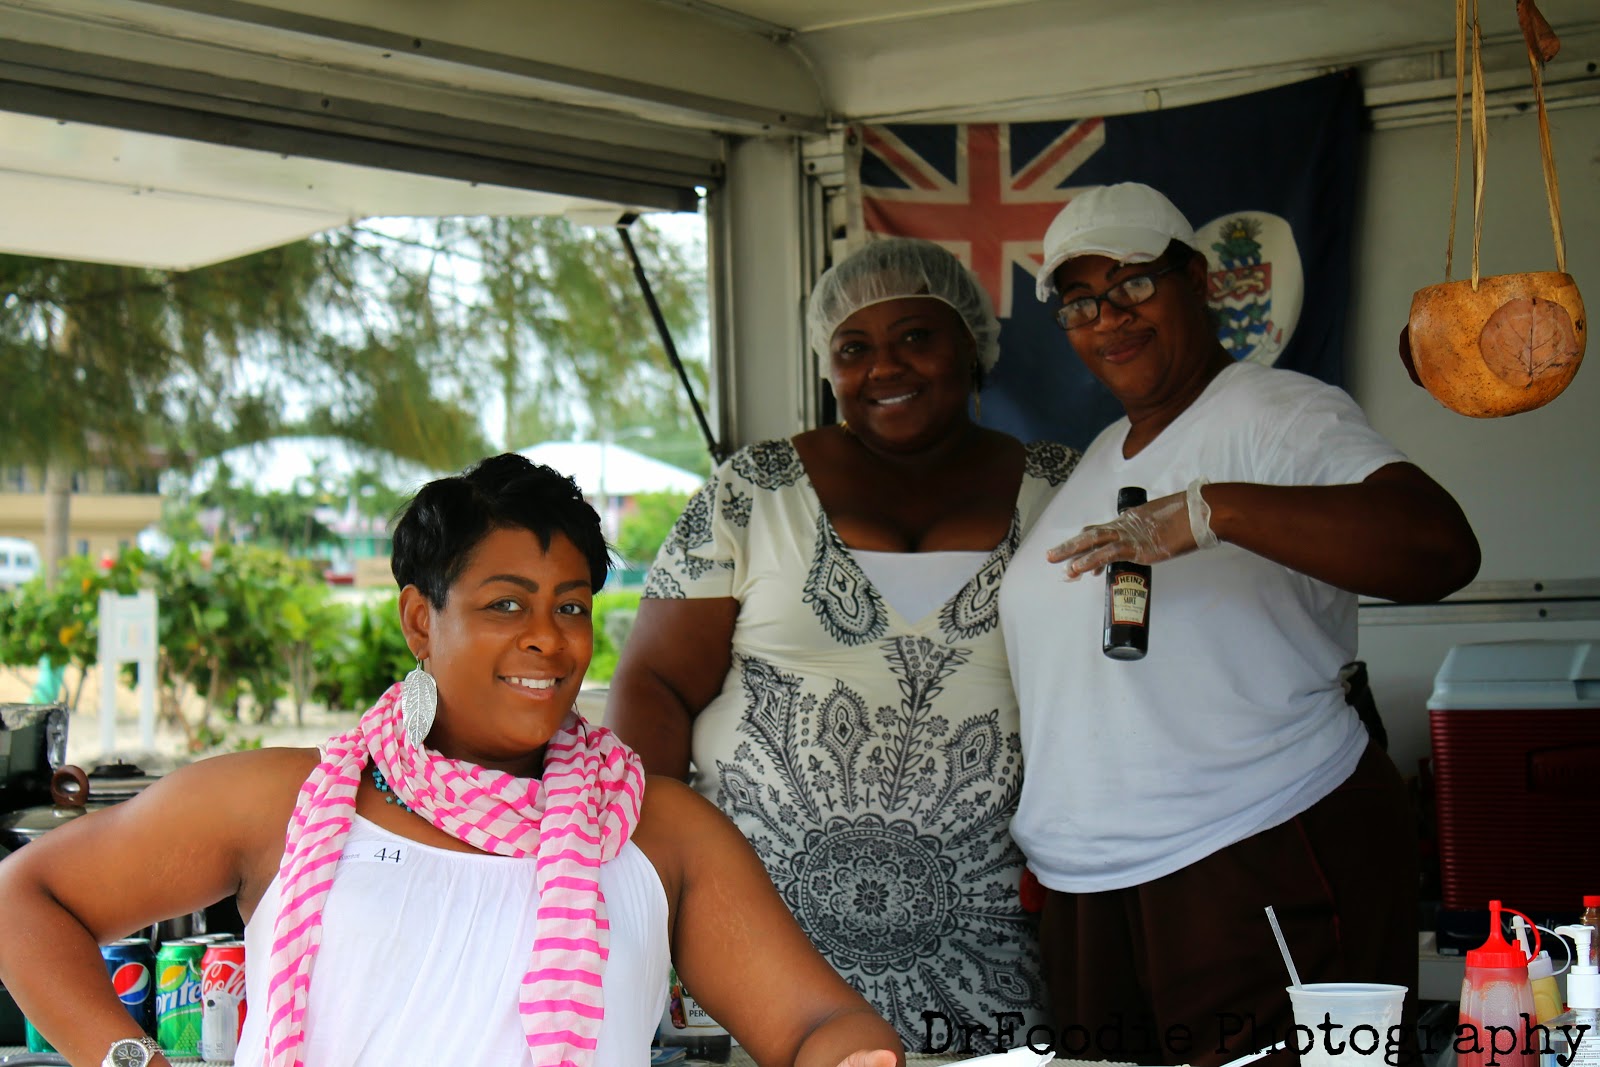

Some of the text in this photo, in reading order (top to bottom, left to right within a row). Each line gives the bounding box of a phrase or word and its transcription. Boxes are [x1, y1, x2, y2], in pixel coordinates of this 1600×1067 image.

[1120, 576, 1143, 585] HEINZ
[1123, 596, 1137, 605] SAUCE
[374, 848, 401, 863] 44
[156, 973, 202, 1017] prite
